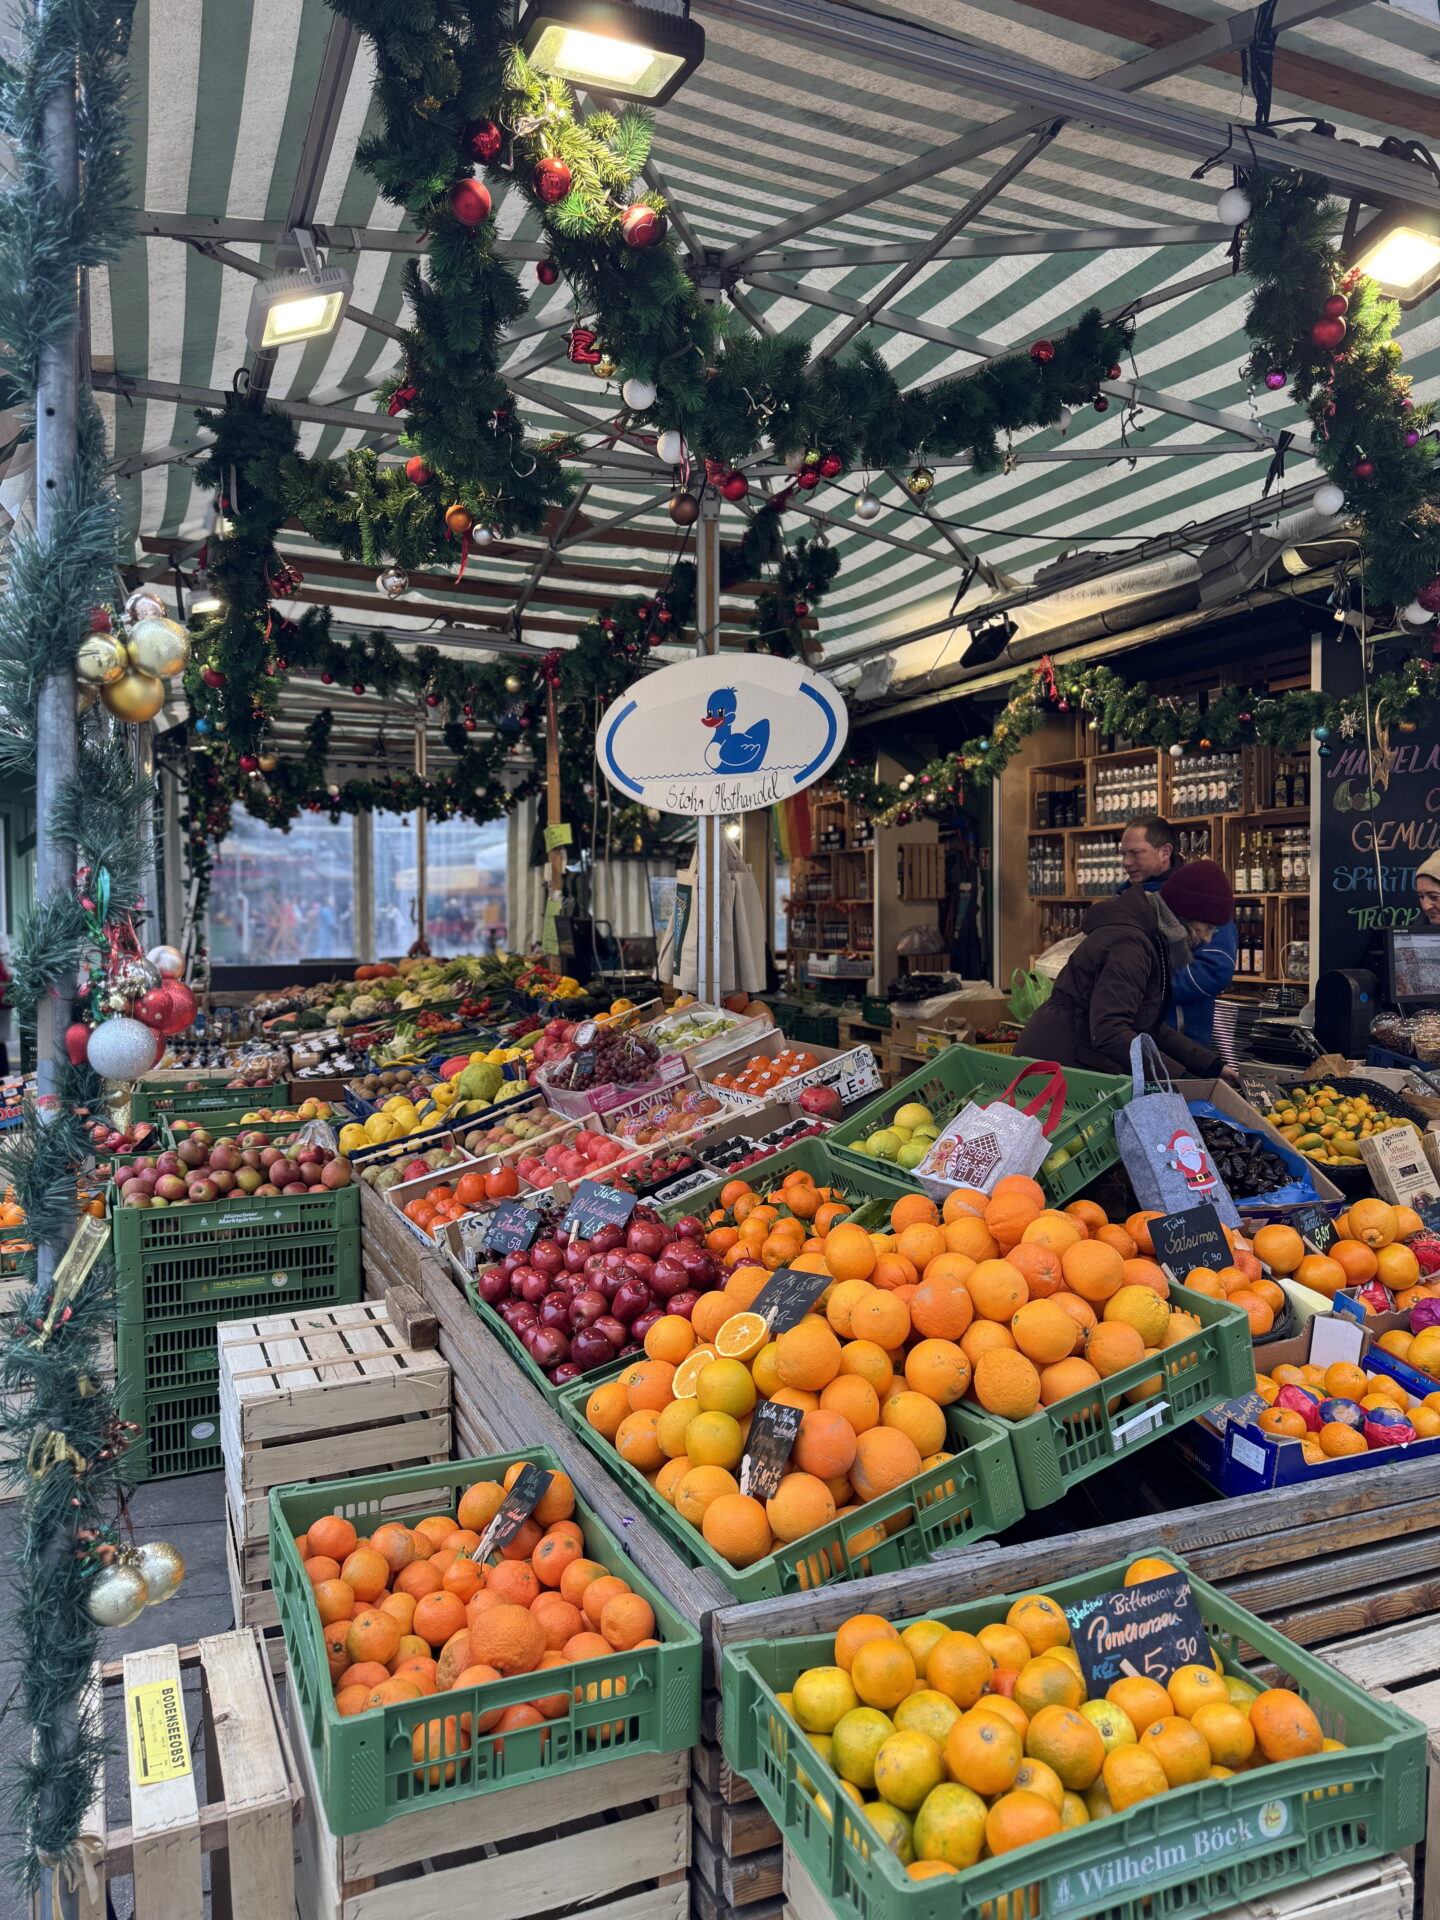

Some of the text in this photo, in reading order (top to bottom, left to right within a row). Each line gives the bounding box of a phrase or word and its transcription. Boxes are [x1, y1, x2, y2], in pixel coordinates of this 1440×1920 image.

[218, 1216, 264, 1225] Marktgärtner
[162, 1687, 186, 1769] BODENSEEOBST
[1077, 1817, 1255, 1899] Wilhelm Böck
